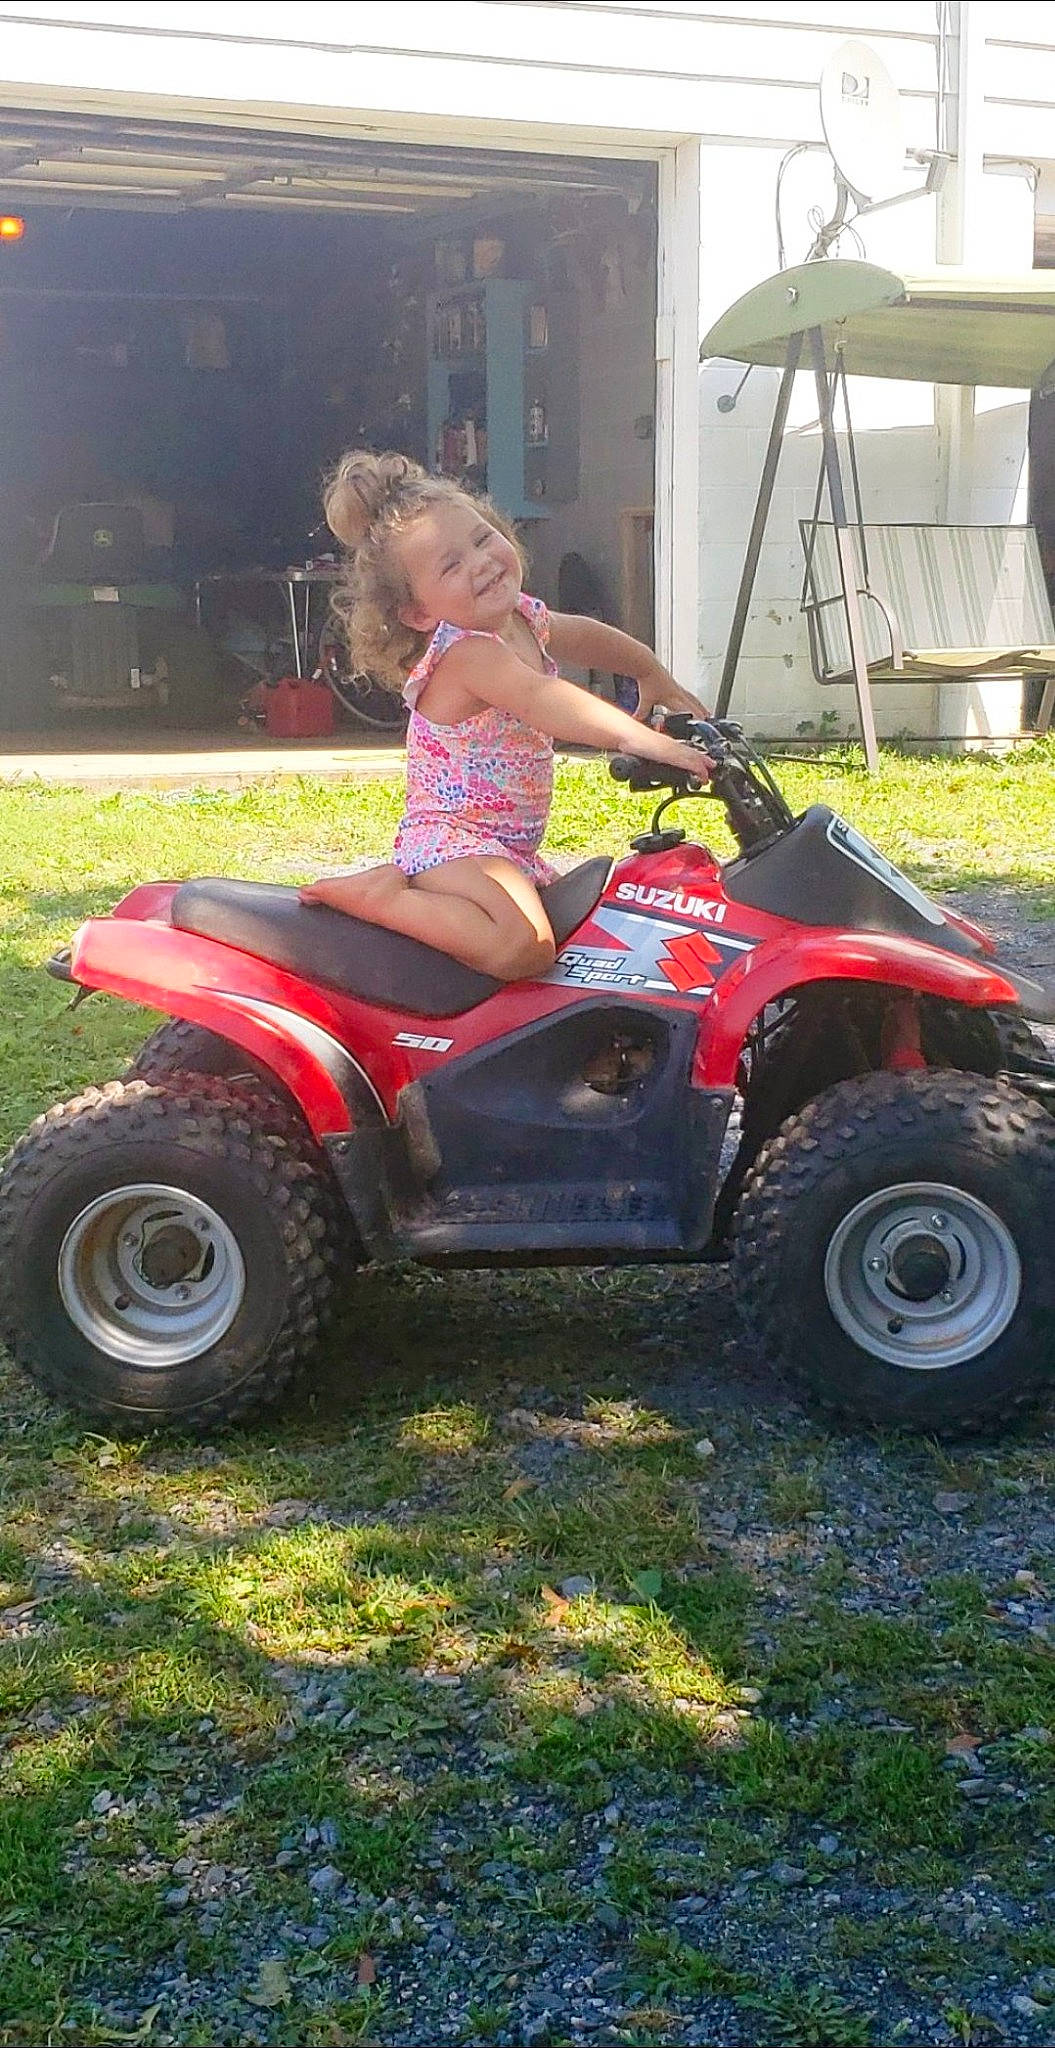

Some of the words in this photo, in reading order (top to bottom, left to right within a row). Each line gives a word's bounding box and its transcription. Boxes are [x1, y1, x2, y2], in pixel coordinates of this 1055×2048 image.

[617, 882, 728, 924] SUZUKI
[556, 951, 627, 971] Quad
[567, 966, 647, 986] Sport
[391, 1032, 454, 1053] 50
